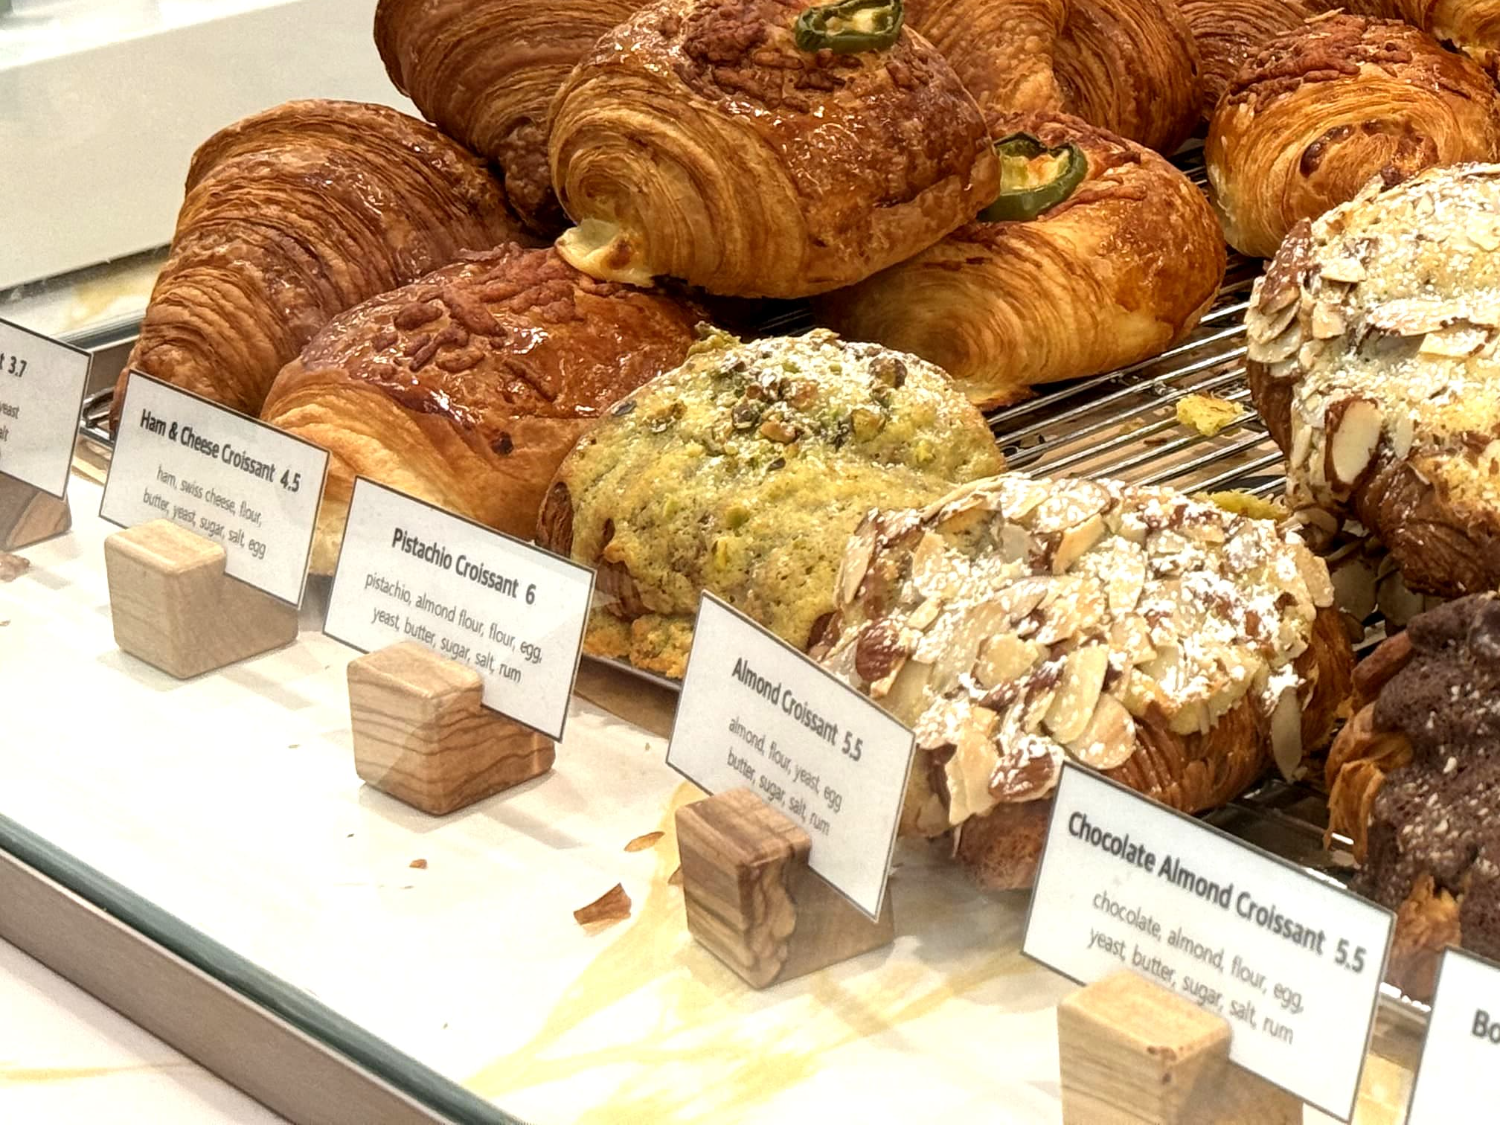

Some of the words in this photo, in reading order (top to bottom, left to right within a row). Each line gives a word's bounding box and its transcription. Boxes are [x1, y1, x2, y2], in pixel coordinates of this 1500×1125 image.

[8, 355, 28, 378] 3.7
[0, 426, 9, 442] alt
[140, 409, 167, 437] Ham
[168, 422, 179, 442] &
[180, 426, 220, 459] Cheese
[221, 443, 276, 483] Croissant
[279, 469, 302, 493] 4.5
[143, 488, 170, 515] butter,
[172, 505, 197, 526] yeast,
[199, 517, 225, 538] sugar,
[228, 528, 246, 548] salt,
[248, 540, 267, 560] egg
[180, 478, 203, 499] swiss
[205, 488, 236, 516] cheese,
[239, 501, 262, 527] flour,
[391, 527, 453, 570] Pistachio
[455, 554, 519, 599] Croissant
[525, 583, 537, 605] 6
[364, 572, 412, 606] pistachio,
[415, 593, 457, 622] almond
[458, 609, 485, 637] flour,
[488, 623, 516, 652] flour,
[519, 640, 543, 664] egg,
[371, 607, 401, 632] yeast,
[404, 616, 436, 649] butter,
[440, 636, 471, 663] sugar,
[475, 652, 495, 675] salt,
[499, 663, 522, 684] rum
[731, 657, 783, 706] Almond
[781, 689, 839, 746] Croissant
[841, 731, 864, 762] 5.5
[727, 747, 757, 785] butter,
[758, 773, 786, 808] sugar,
[788, 796, 807, 823] salt,
[809, 810, 831, 837] rum
[728, 717, 767, 756] almond,
[768, 740, 792, 775] flour,
[823, 785, 843, 814] egg
[1067, 811, 1157, 873] Chocolate
[1157, 854, 1234, 910] Almond
[1235, 890, 1327, 956] Croissant
[1333, 937, 1367, 974] 5.5
[1087, 926, 1127, 962] yeast,
[1130, 944, 1177, 989] butter,
[1181, 974, 1224, 1011] sugar,
[1229, 997, 1257, 1031] salt,
[1262, 1014, 1294, 1045] rum
[1092, 889, 1162, 943] chocolate,
[1167, 926, 1225, 973] almond,
[1230, 954, 1268, 995] flour,
[1272, 981, 1305, 1015] egg,
